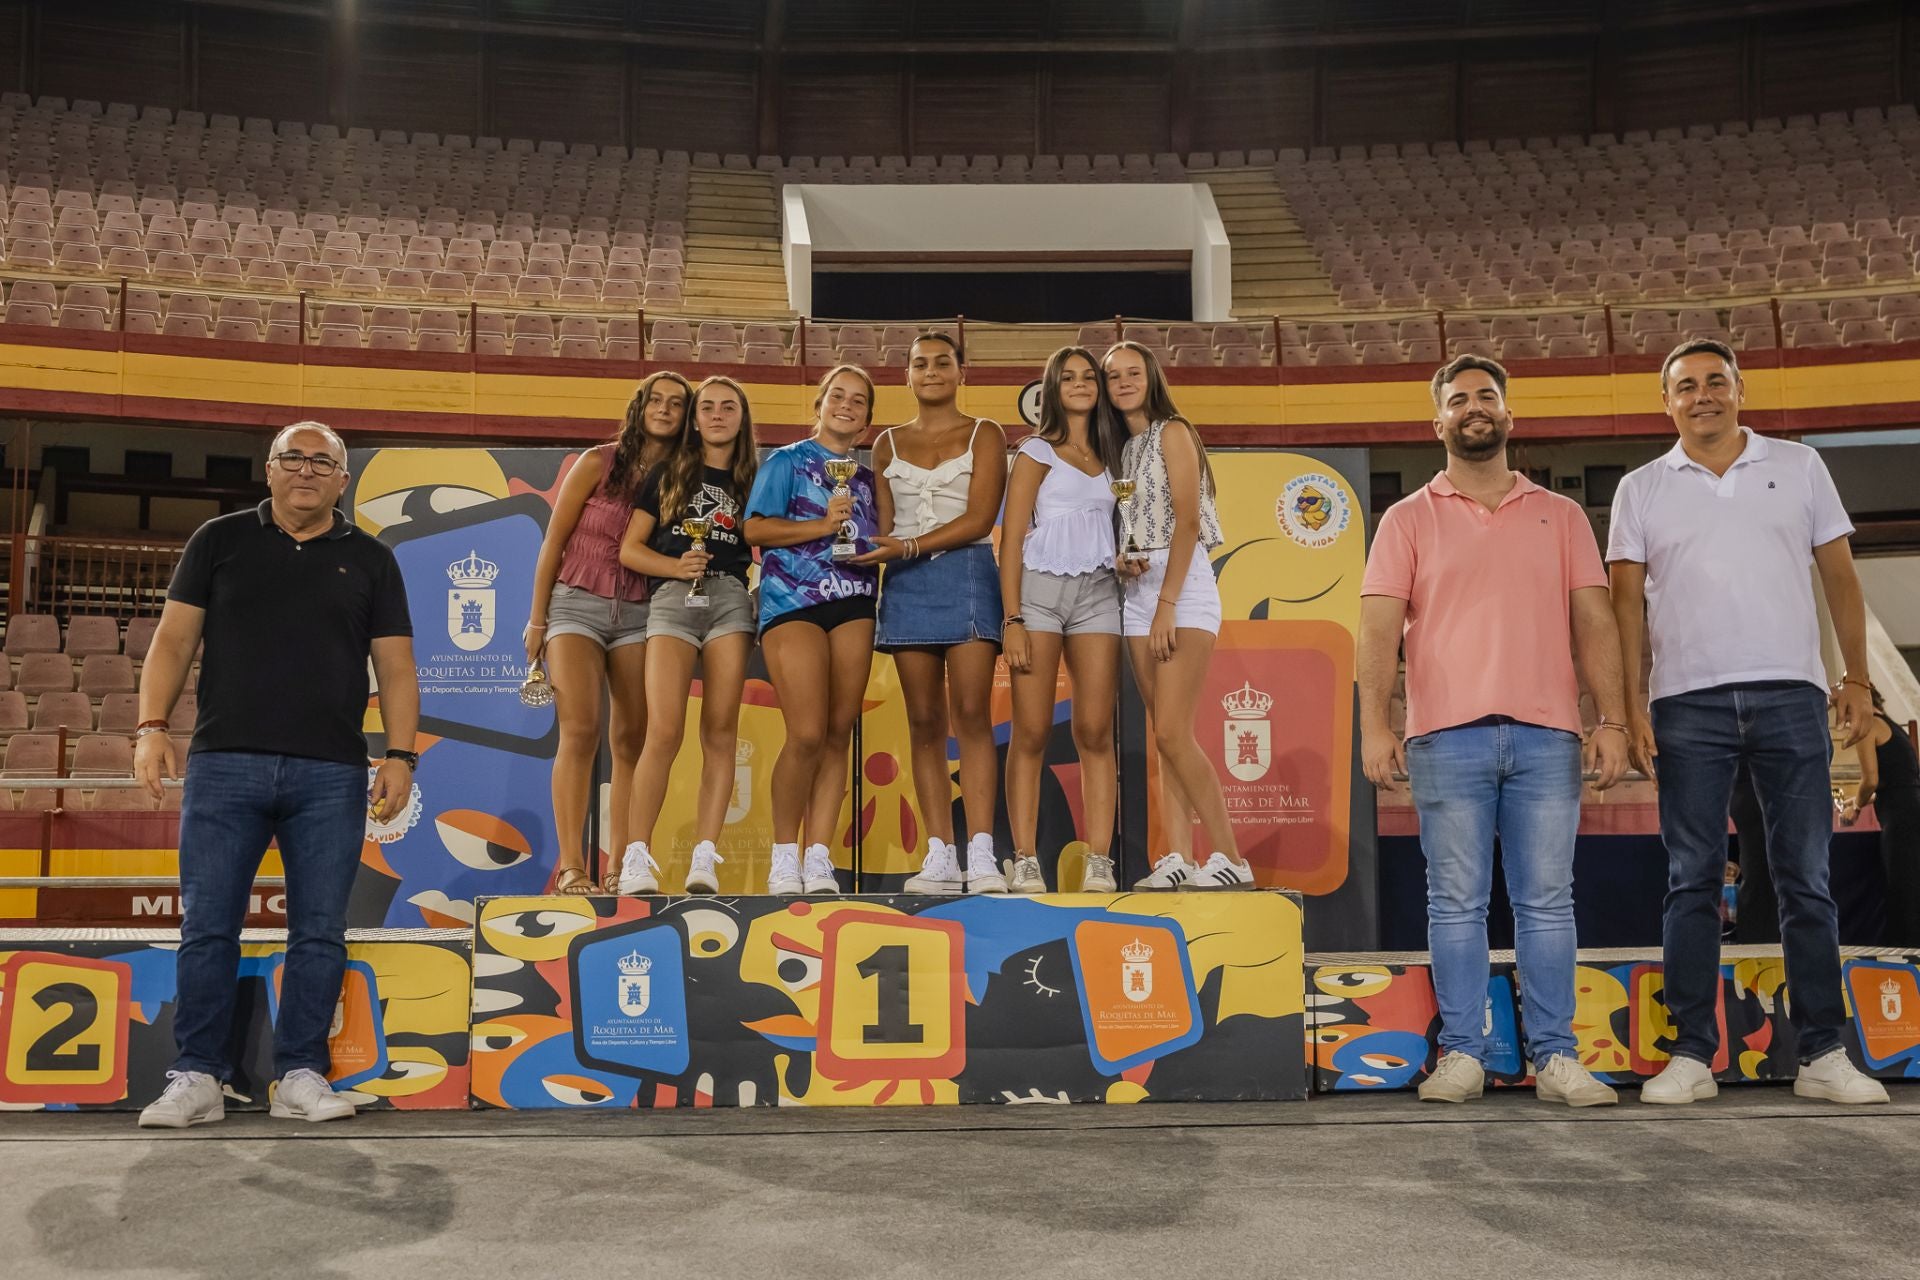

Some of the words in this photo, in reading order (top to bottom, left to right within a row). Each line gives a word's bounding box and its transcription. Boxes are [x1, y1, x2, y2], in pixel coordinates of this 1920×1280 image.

[1286, 474, 1336, 491] ROQUETAS
[1336, 490, 1347, 503] DE
[1338, 509, 1349, 529] MAR
[1311, 536, 1334, 547] VIDA
[430, 654, 499, 662] AYUNTAMIENTO
[501, 654, 513, 662] DE
[480, 667, 496, 677] DE
[432, 686, 463, 694] Deportes,
[494, 686, 519, 694] Tiempo
[1222, 785, 1277, 793] NTAMIENTO
[1279, 785, 1290, 793] DE
[1259, 797, 1274, 808] DE
[1279, 795, 1310, 808] MAR
[1272, 817, 1297, 825] Tiempo
[379, 831, 402, 842] VIDA
[856, 945, 924, 1044] 1
[1100, 1011, 1141, 1021] ROQUETAS
[1157, 1010, 1177, 1019] MAR
[26, 983, 100, 1071] 2
[593, 1025, 637, 1036] ROQUETAS
[653, 1025, 675, 1034] MAR
